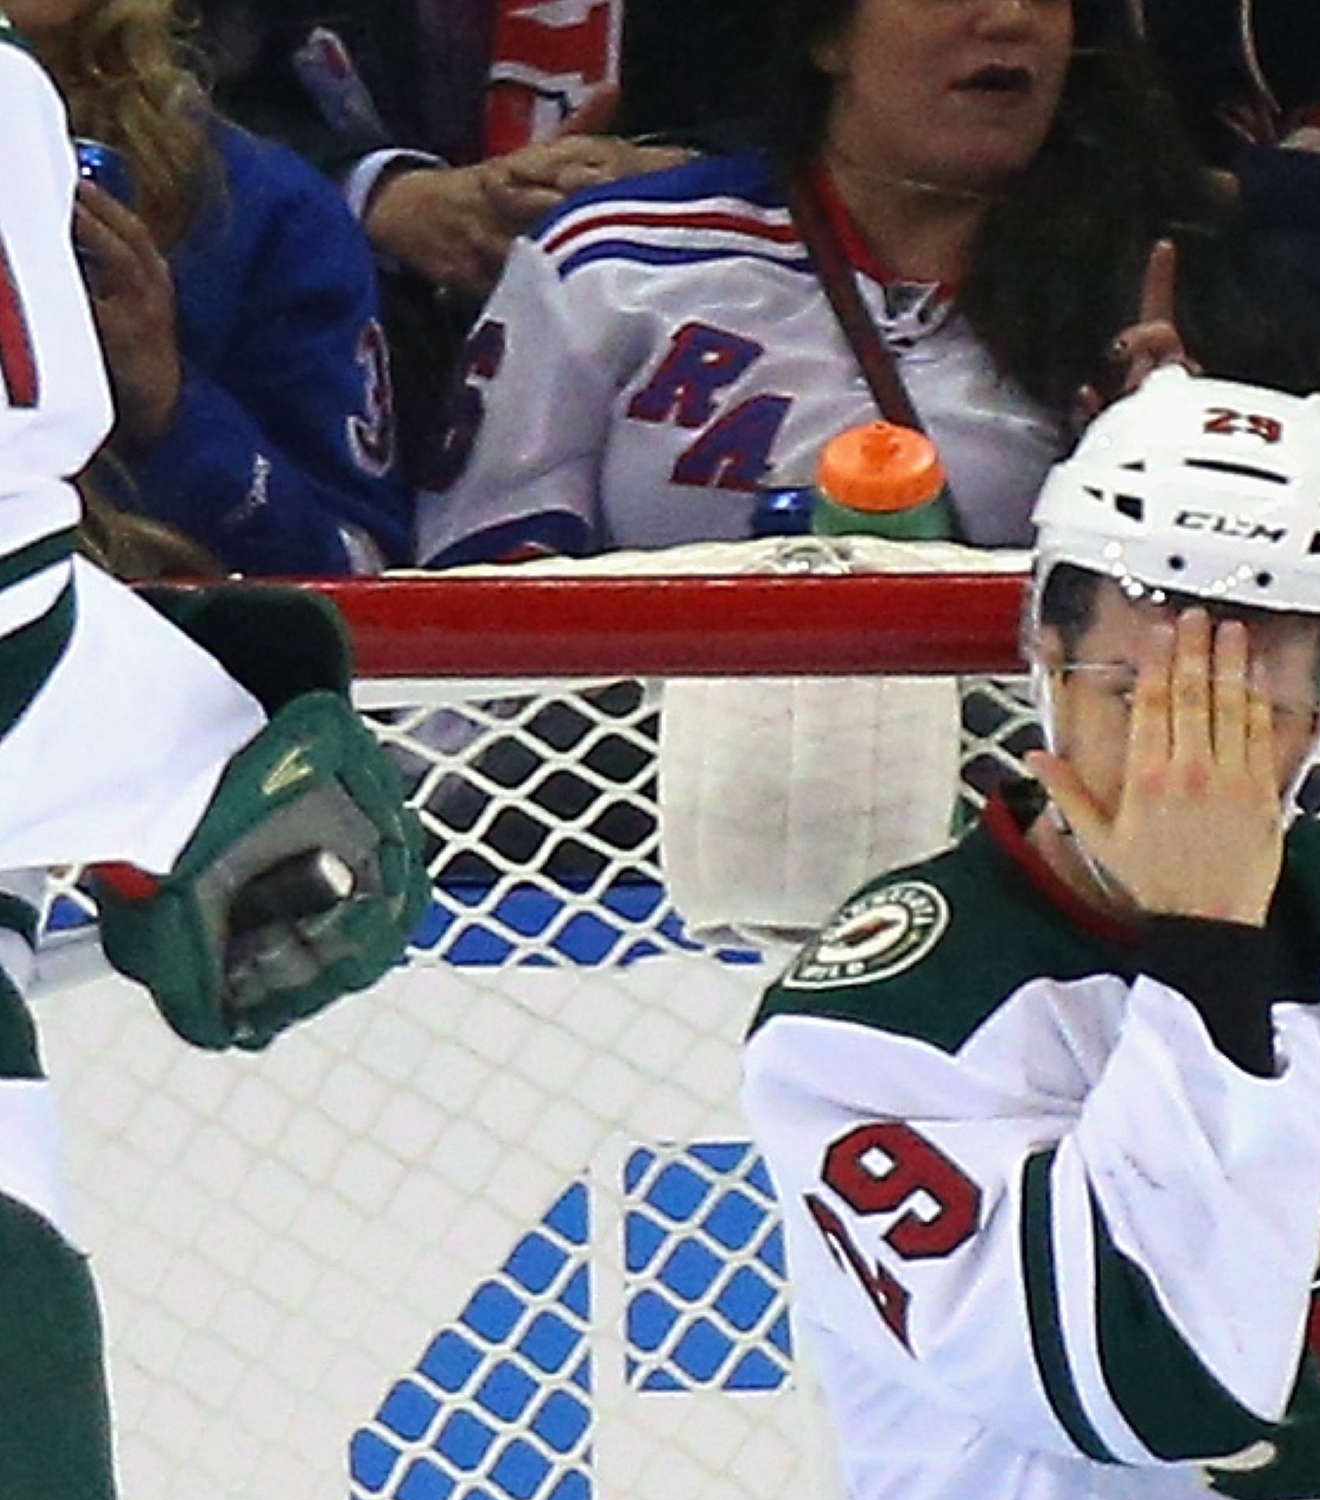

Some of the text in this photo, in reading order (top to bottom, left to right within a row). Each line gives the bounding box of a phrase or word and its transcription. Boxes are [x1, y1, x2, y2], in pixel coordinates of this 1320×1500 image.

[1203, 406, 1283, 444] 29
[1175, 511, 1287, 543] CCM
[802, 1117, 983, 1361] 29
